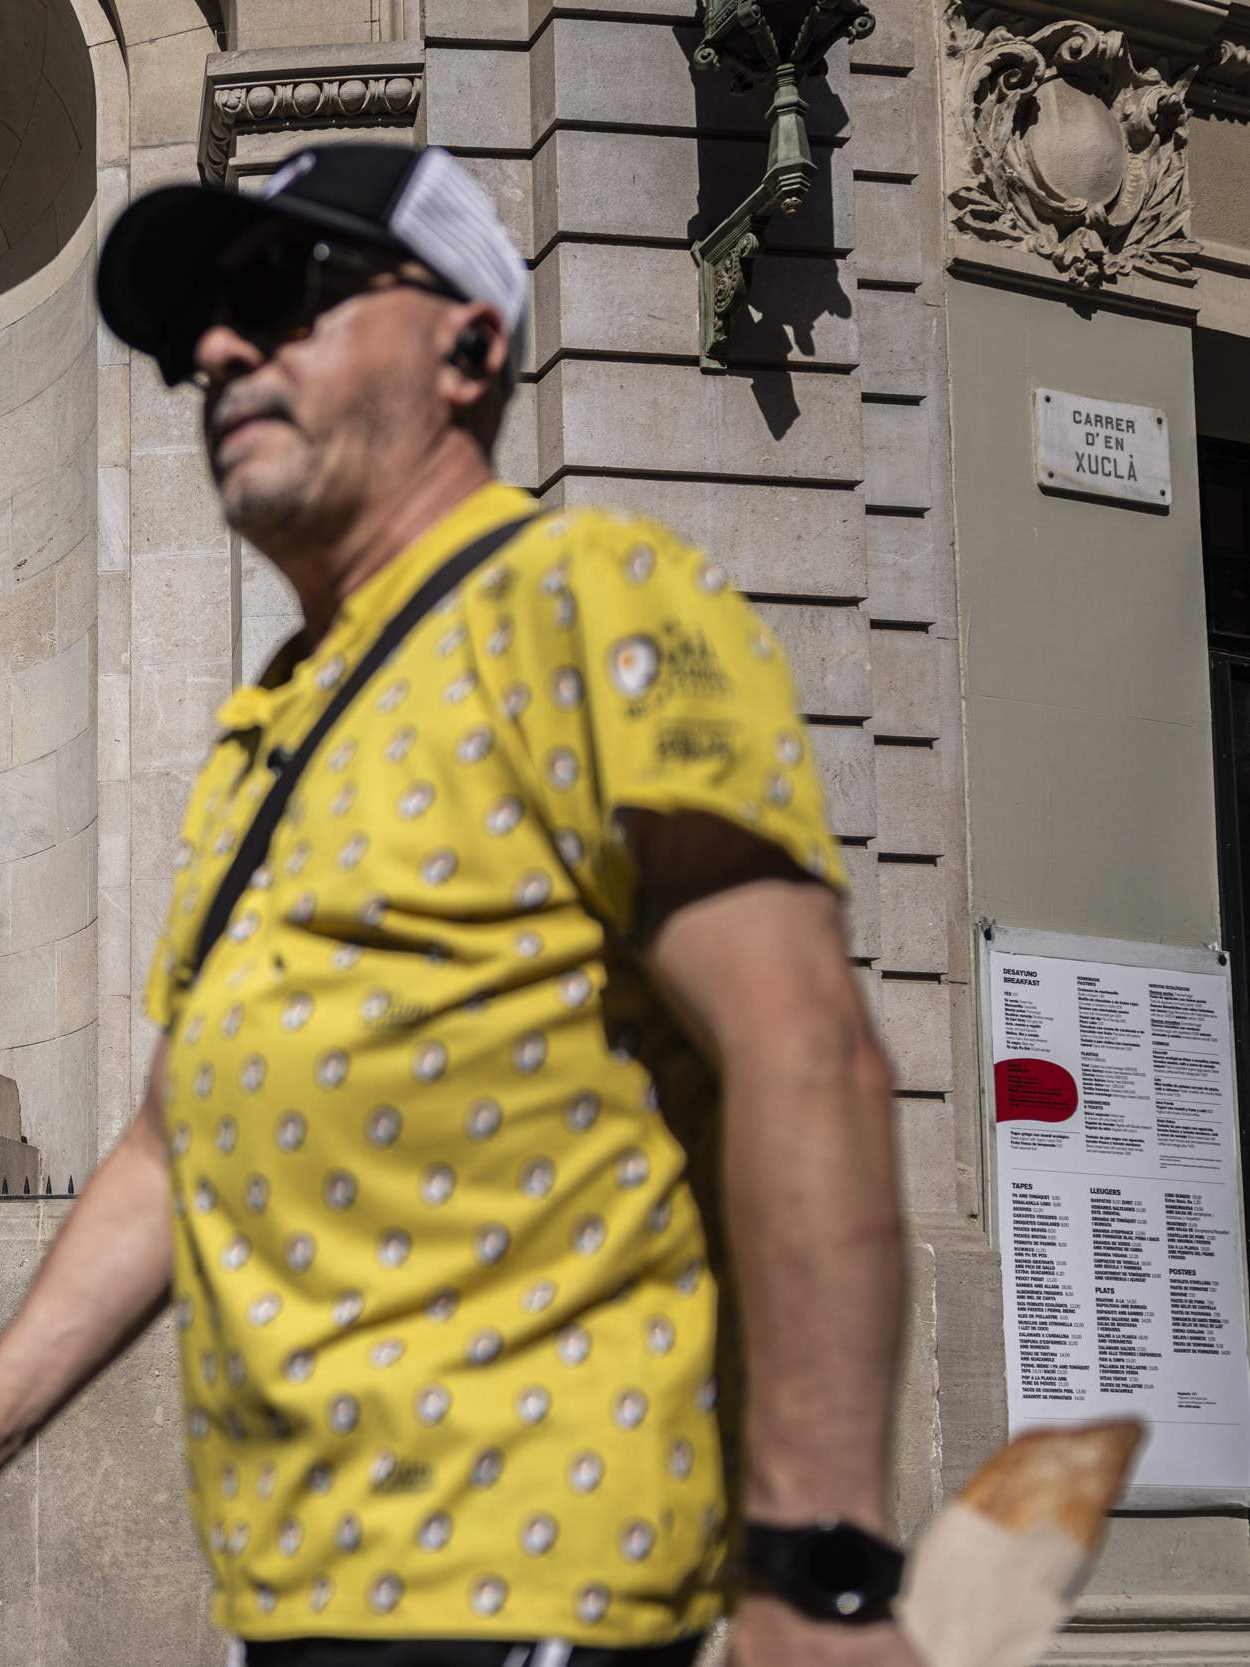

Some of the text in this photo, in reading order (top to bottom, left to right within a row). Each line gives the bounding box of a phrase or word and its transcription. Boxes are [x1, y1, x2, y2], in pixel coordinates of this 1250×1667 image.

[1073, 410, 1136, 434] CARRER
[1075, 451, 1138, 482] XUCLÀ
[1003, 968, 1038, 977] DESAYUNO
[1003, 976, 1040, 987] BREAKFAST
[1011, 1182, 1033, 1190] TAPES
[1090, 1187, 1121, 1196] LLEUGERS
[1169, 1268, 1197, 1276] POSTRES
[1095, 1287, 1115, 1295] PLATS
